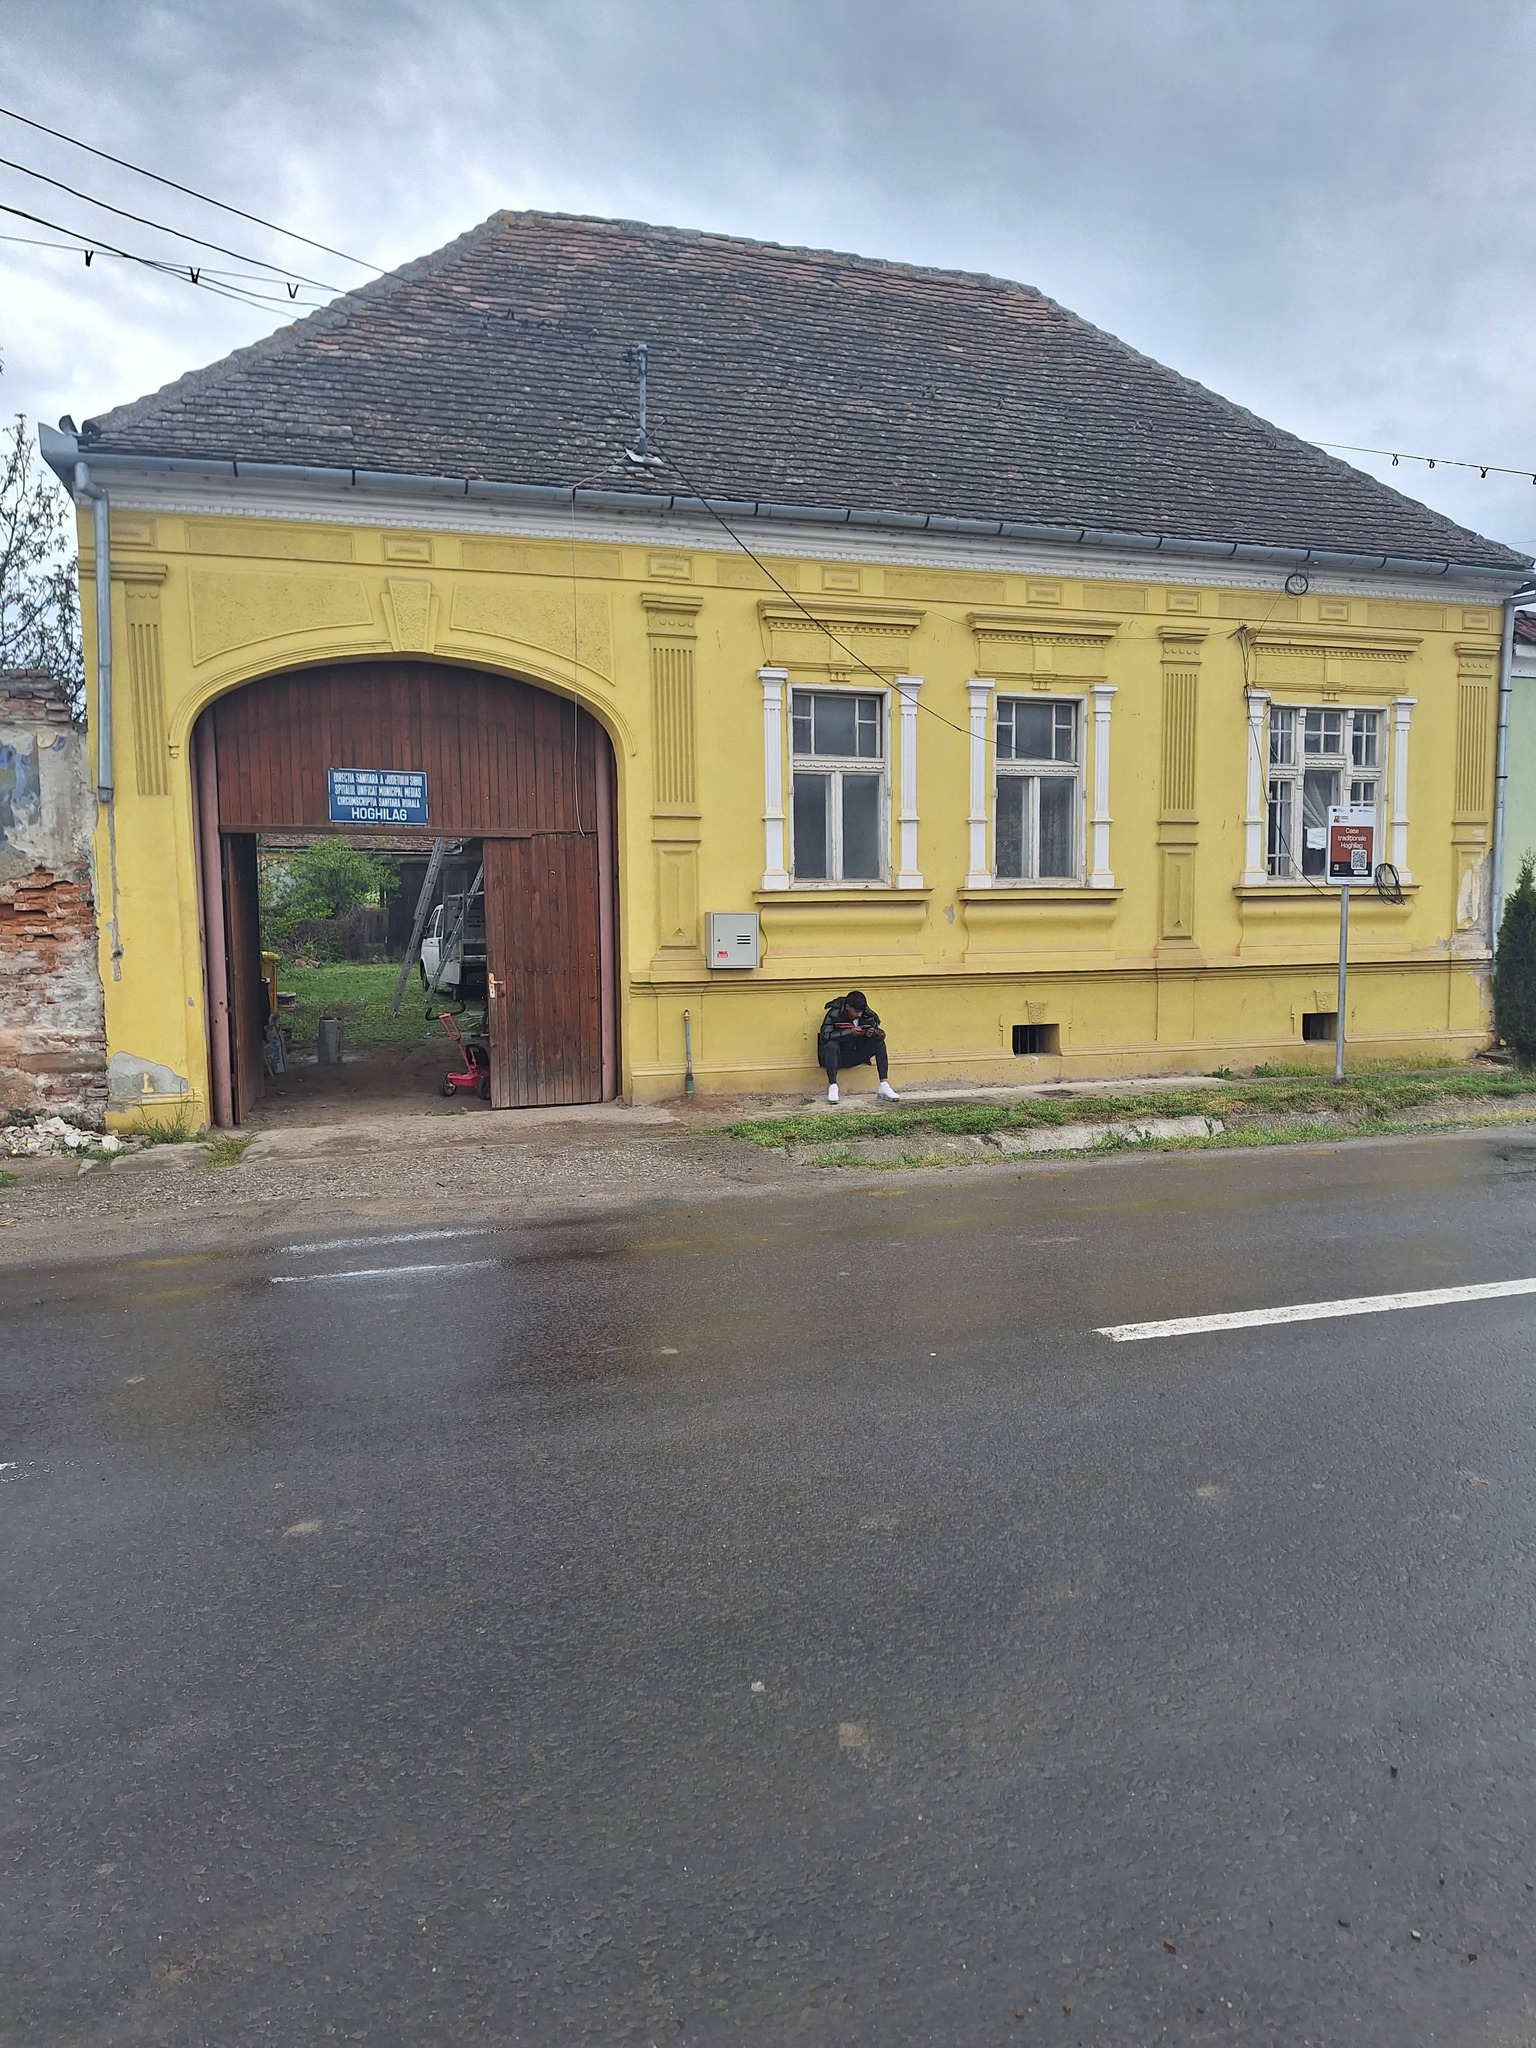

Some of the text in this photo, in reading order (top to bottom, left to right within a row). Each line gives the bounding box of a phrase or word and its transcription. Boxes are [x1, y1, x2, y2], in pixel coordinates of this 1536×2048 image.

[380, 775, 384, 784] A
[410, 776, 422, 786] SIBIU
[334, 784, 356, 795] SPITALUL
[357, 785, 378, 796] UNIFICAT
[379, 786, 403, 797] MUNICIPAL
[352, 807, 407, 820] HOGHILAG
